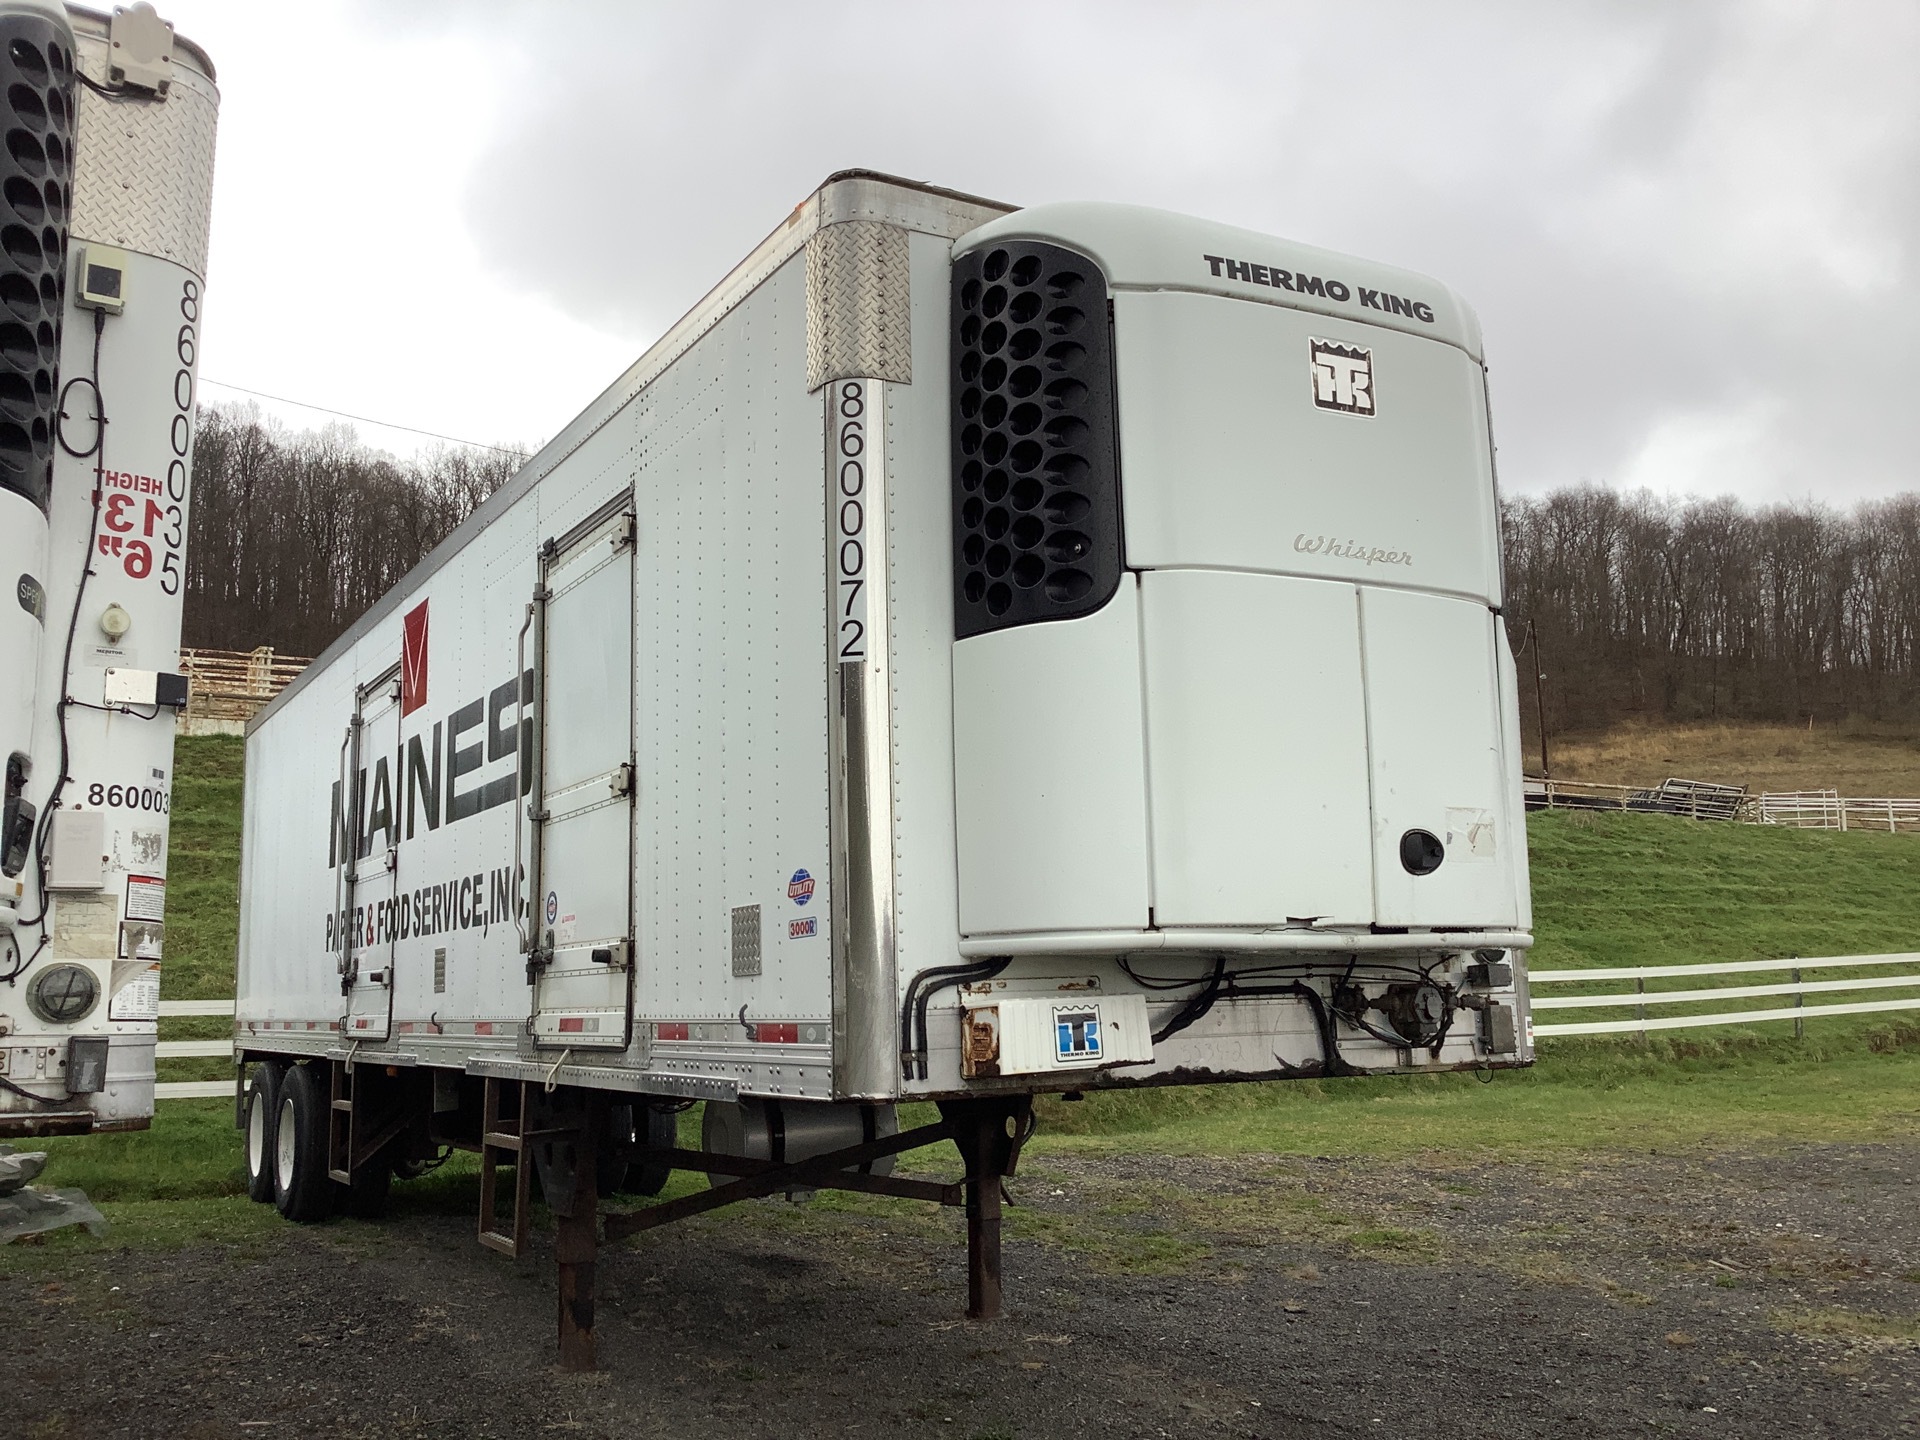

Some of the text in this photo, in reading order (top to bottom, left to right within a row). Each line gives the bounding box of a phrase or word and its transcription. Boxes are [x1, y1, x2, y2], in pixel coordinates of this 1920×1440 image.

[1203, 254, 1435, 323] THERMO KING
[160, 279, 198, 596] 8600035
[840, 382, 864, 657] 8600072
[1293, 533, 1412, 566] Whisper
[789, 880, 814, 897] UTILITY
[366, 903, 375, 947] &
[377, 893, 410, 945] FOOD
[790, 920, 815, 936] 3000R
